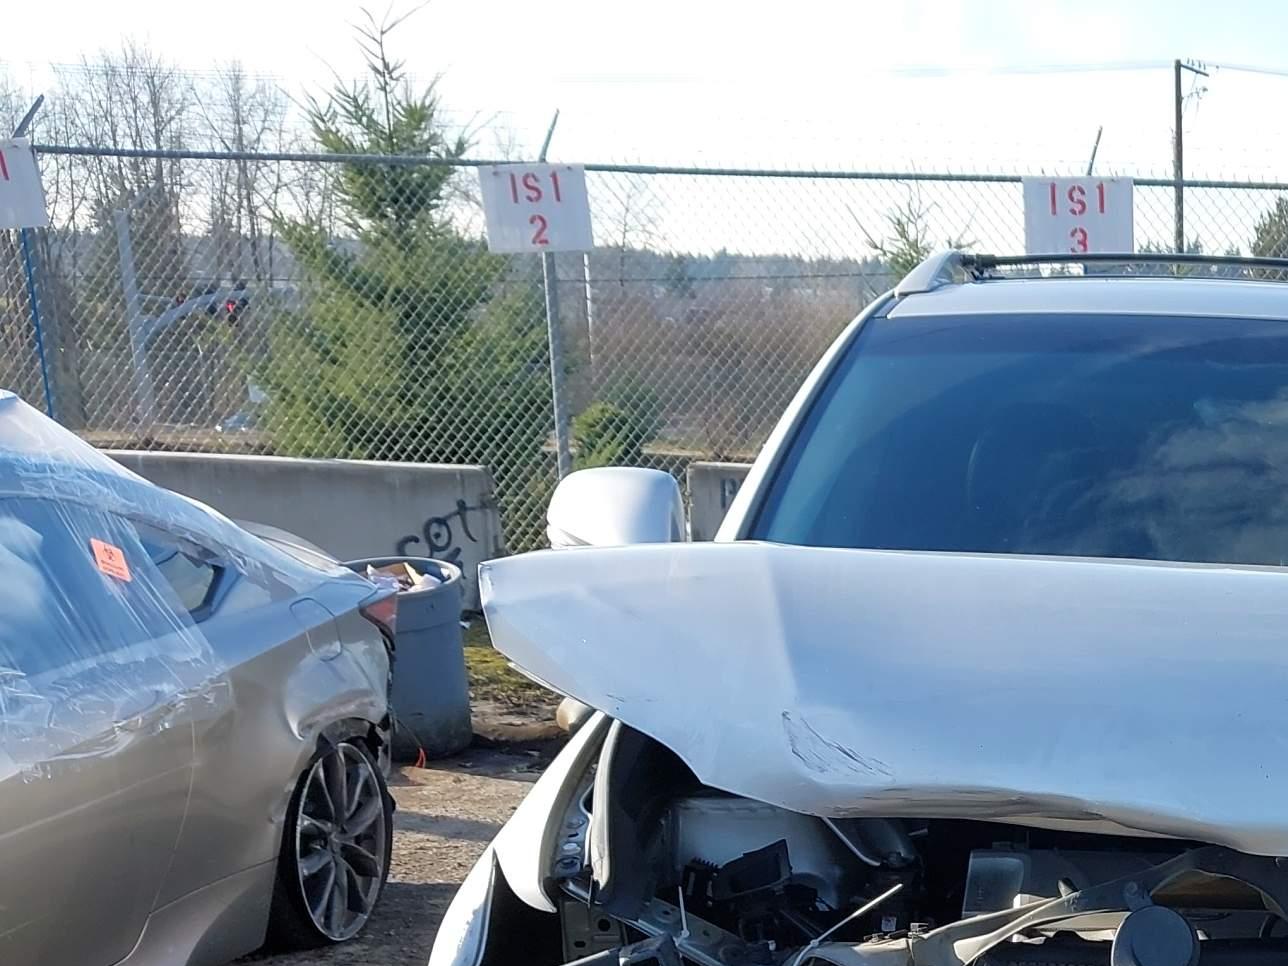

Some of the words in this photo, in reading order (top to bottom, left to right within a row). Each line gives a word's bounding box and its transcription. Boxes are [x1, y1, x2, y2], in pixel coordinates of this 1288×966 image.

[509, 169, 561, 204] IS1
[1050, 181, 1105, 216] IS1
[529, 213, 549, 245] 2
[1070, 226, 1088, 254] 3
